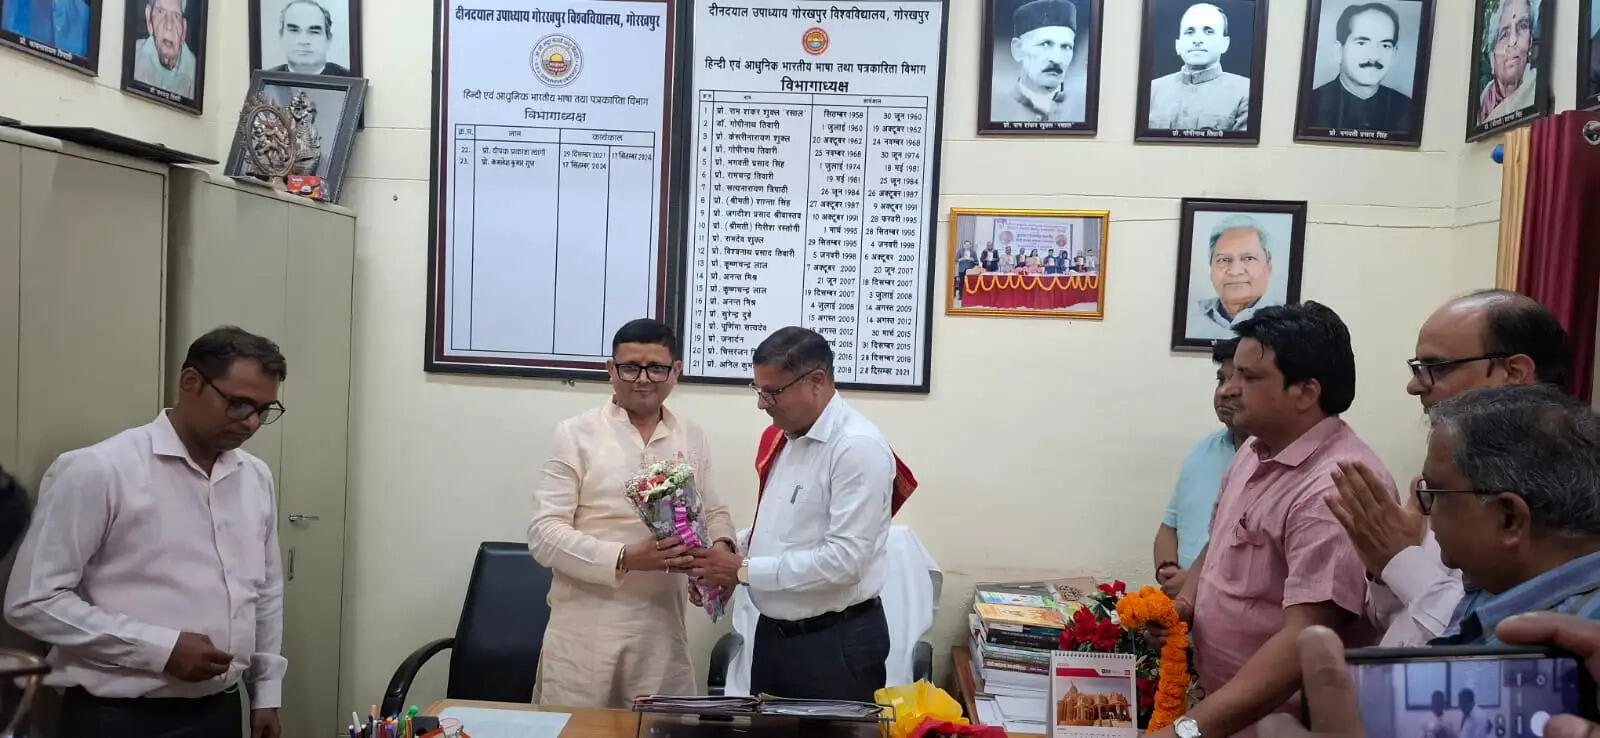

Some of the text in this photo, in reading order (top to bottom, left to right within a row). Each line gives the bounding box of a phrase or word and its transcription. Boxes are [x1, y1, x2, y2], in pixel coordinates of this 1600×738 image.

[456, 5, 660, 31] दीनदयाल उपाध्याय गोरखपुर विश्वविद्यालय, गोरखपुर
[708, 2, 930, 24] दीनदयाल उपाध्याय गोरखपुर विश्वविद्यालय, गोरखपुर
[704, 56, 926, 74] हिन्दी एवं आधुनिक भारतीय भाषा तथा पत्रकारिता विभाग
[781, 76, 849, 93] विभागाध्यक्ष
[463, 89, 648, 106] हिन्दी एवं आधुनिक भारतीय भाषा तथा पत्रकारिता विभाग
[524, 107, 586, 123] विभागाध्यक्ष
[762, 109, 780, 118] शुक्ल
[894, 113, 905, 122] जून
[716, 118, 726, 127] डॉ.
[730, 118, 756, 128] गोपीनाथ
[759, 120, 780, 129] तिवारी
[882, 126, 904, 135] अक्टूबर
[774, 135, 790, 144] शुक्ल
[728, 144, 755, 154] गोपीनाथ
[757, 145, 777, 154] तिवारी
[891, 152, 902, 161] जून
[728, 157, 749, 166] भगवती
[772, 159, 784, 168] सिंह
[894, 163, 904, 172] मई
[754, 171, 774, 180] तिवारी
[890, 178, 901, 187] जून
[767, 184, 788, 194] त्रिपाठी
[879, 190, 902, 199] अक्टूबर
[778, 197, 790, 207] सिंह
[880, 203, 903, 212] अक्टूबर
[726, 208, 750, 217] जगदीश
[774, 210, 802, 219] श्रीवास्तव
[881, 214, 900, 222] फरवरी
[755, 222, 775, 231] गिरीश
[777, 223, 800, 232] रस्तोगी
[876, 226, 899, 236] सितम्बर
[724, 234, 744, 243] रामदेव
[747, 236, 764, 246] शुक्ल
[878, 240, 898, 248] जनवरी
[724, 246, 752, 256] विश्वनाथ
[775, 248, 794, 258] तिवारी
[871, 254, 894, 263] अक्टूबर
[724, 261, 751, 270] कृष्णचन्द्र
[884, 267, 895, 276] जून
[744, 272, 757, 281] मिश्र
[872, 276, 895, 286] दिसम्बर
[722, 286, 750, 295] कृष्णचन्द्र
[875, 290, 894, 301] जुलाई
[743, 297, 756, 306] मिश्र
[722, 310, 739, 320] सुरेन्द्र
[741, 310, 751, 321] दुबे
[744, 323, 766, 331] सत्यदेव
[882, 328, 894, 336] मार्च
[720, 334, 744, 343] जनार्दन
[871, 340, 894, 349] दिसम्बर
[870, 351, 894, 361] दिसम्बर
[720, 359, 892, 375] अनिल दिसम्बर
